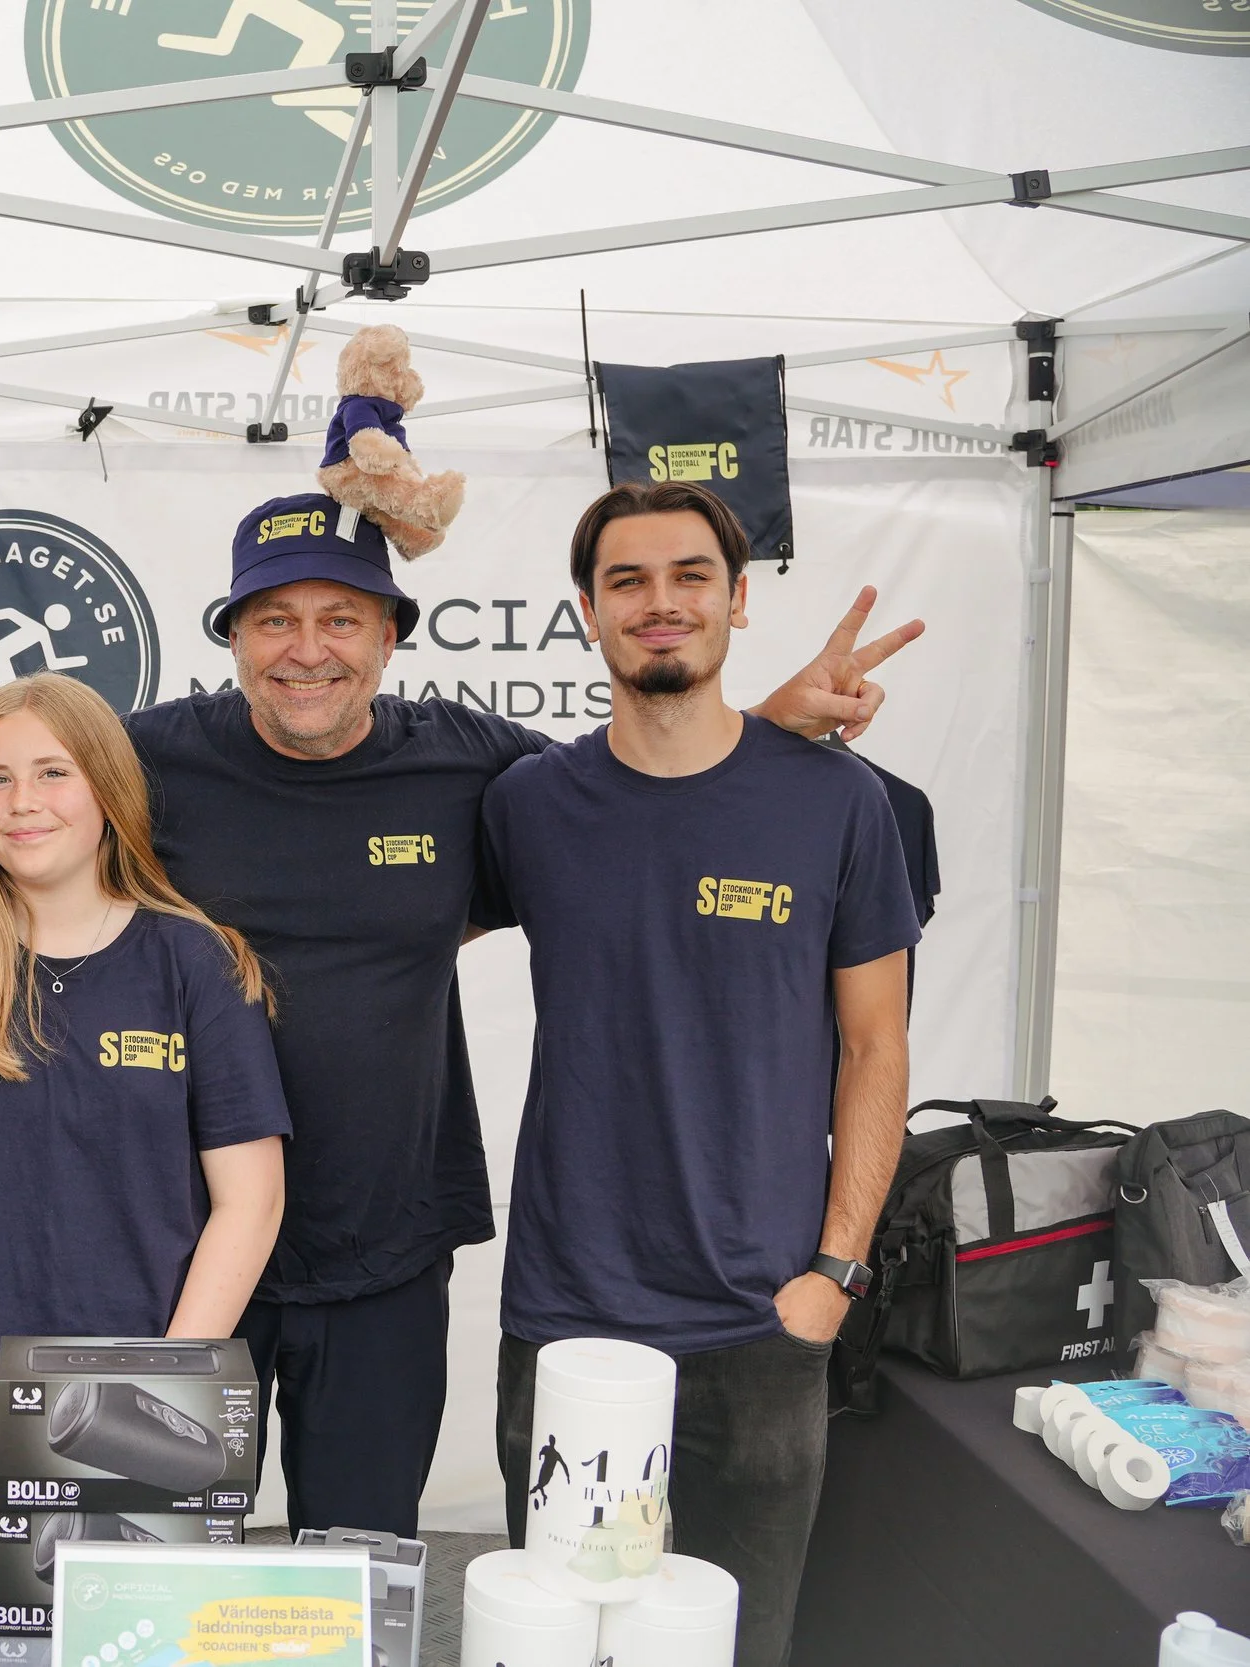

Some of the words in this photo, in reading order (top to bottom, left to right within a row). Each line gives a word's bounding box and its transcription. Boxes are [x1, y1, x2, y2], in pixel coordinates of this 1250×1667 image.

[671, 450, 707, 459] STOCKHOLM
[671, 459, 700, 467] FOOTBALL
[672, 469, 684, 477] CUP
[722, 884, 762, 896] STOCKHOLM
[721, 893, 752, 904] FOOTBALL
[720, 903, 734, 912] CUP
[124, 1035, 160, 1046] STOCKHOLM
[124, 1044, 154, 1054] FOOTBALL
[124, 1053, 137, 1061] CUP
[1060, 1339, 1100, 1362] FIRST
[1101, 1336, 1116, 1353] AI
[1133, 1423, 1166, 1436] ICE
[7, 1480, 60, 1500] BOLD
[114, 1583, 172, 1593] OFFICIAL
[219, 1604, 288, 1620] Världens
[291, 1605, 334, 1620] bästa
[197, 1621, 307, 1637] laddningsbara
[311, 1624, 356, 1638] pump
